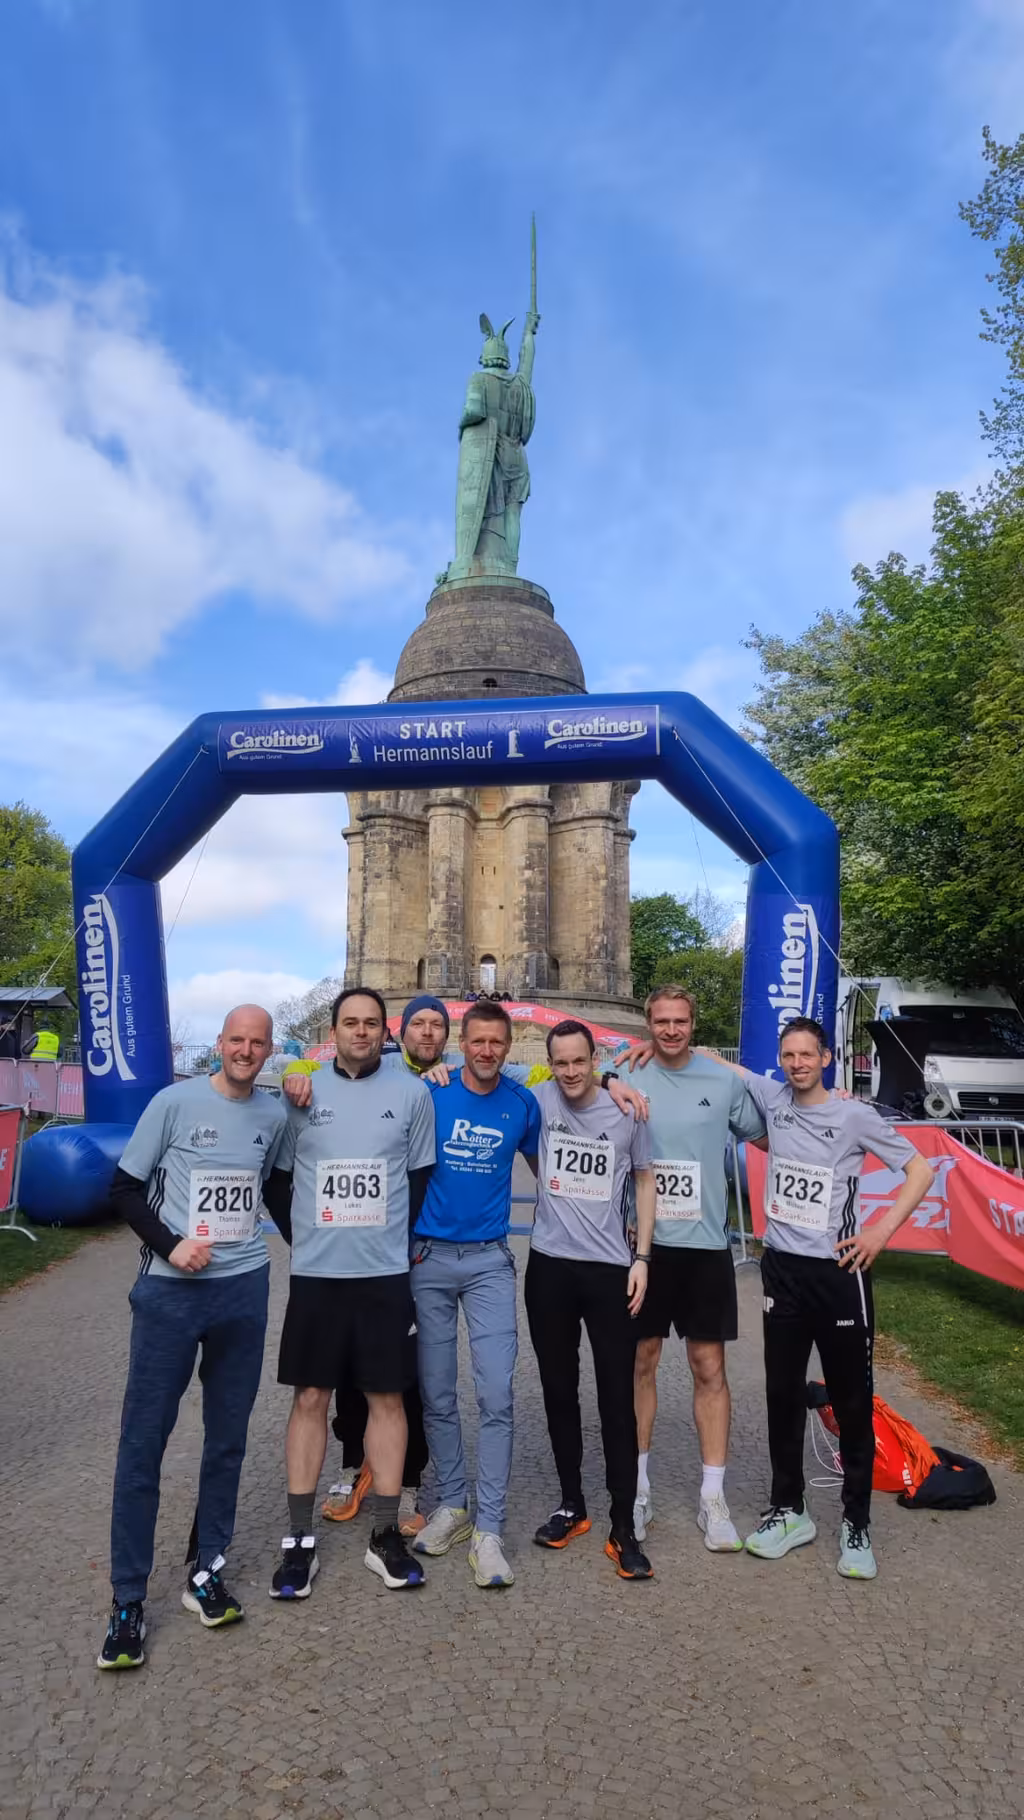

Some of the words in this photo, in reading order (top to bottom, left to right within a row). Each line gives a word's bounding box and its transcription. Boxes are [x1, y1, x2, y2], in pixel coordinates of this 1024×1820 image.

[400, 721, 466, 740] START
[547, 716, 646, 738] Carolinen
[230, 730, 321, 749] Carolinen
[374, 740, 493, 762] Hermannslauf
[82, 900, 113, 1076] Carolinen
[121, 974, 132, 1004] Grund
[765, 909, 808, 1078] olinen
[815, 993, 825, 1025] Grund
[123, 1007, 137, 1035] gutem
[126, 1037, 136, 1057] Aus
[558, 1138, 610, 1151] HERMANNSLAUF
[554, 1147, 607, 1176] 1208
[322, 1174, 381, 1199] 4963
[563, 1185, 605, 1197] Sparkasse
[775, 1172, 824, 1205] 1232
[197, 1186, 253, 1213] 2820
[336, 1213, 381, 1223] Sparkasse
[836, 1319, 855, 1327] JAKO
